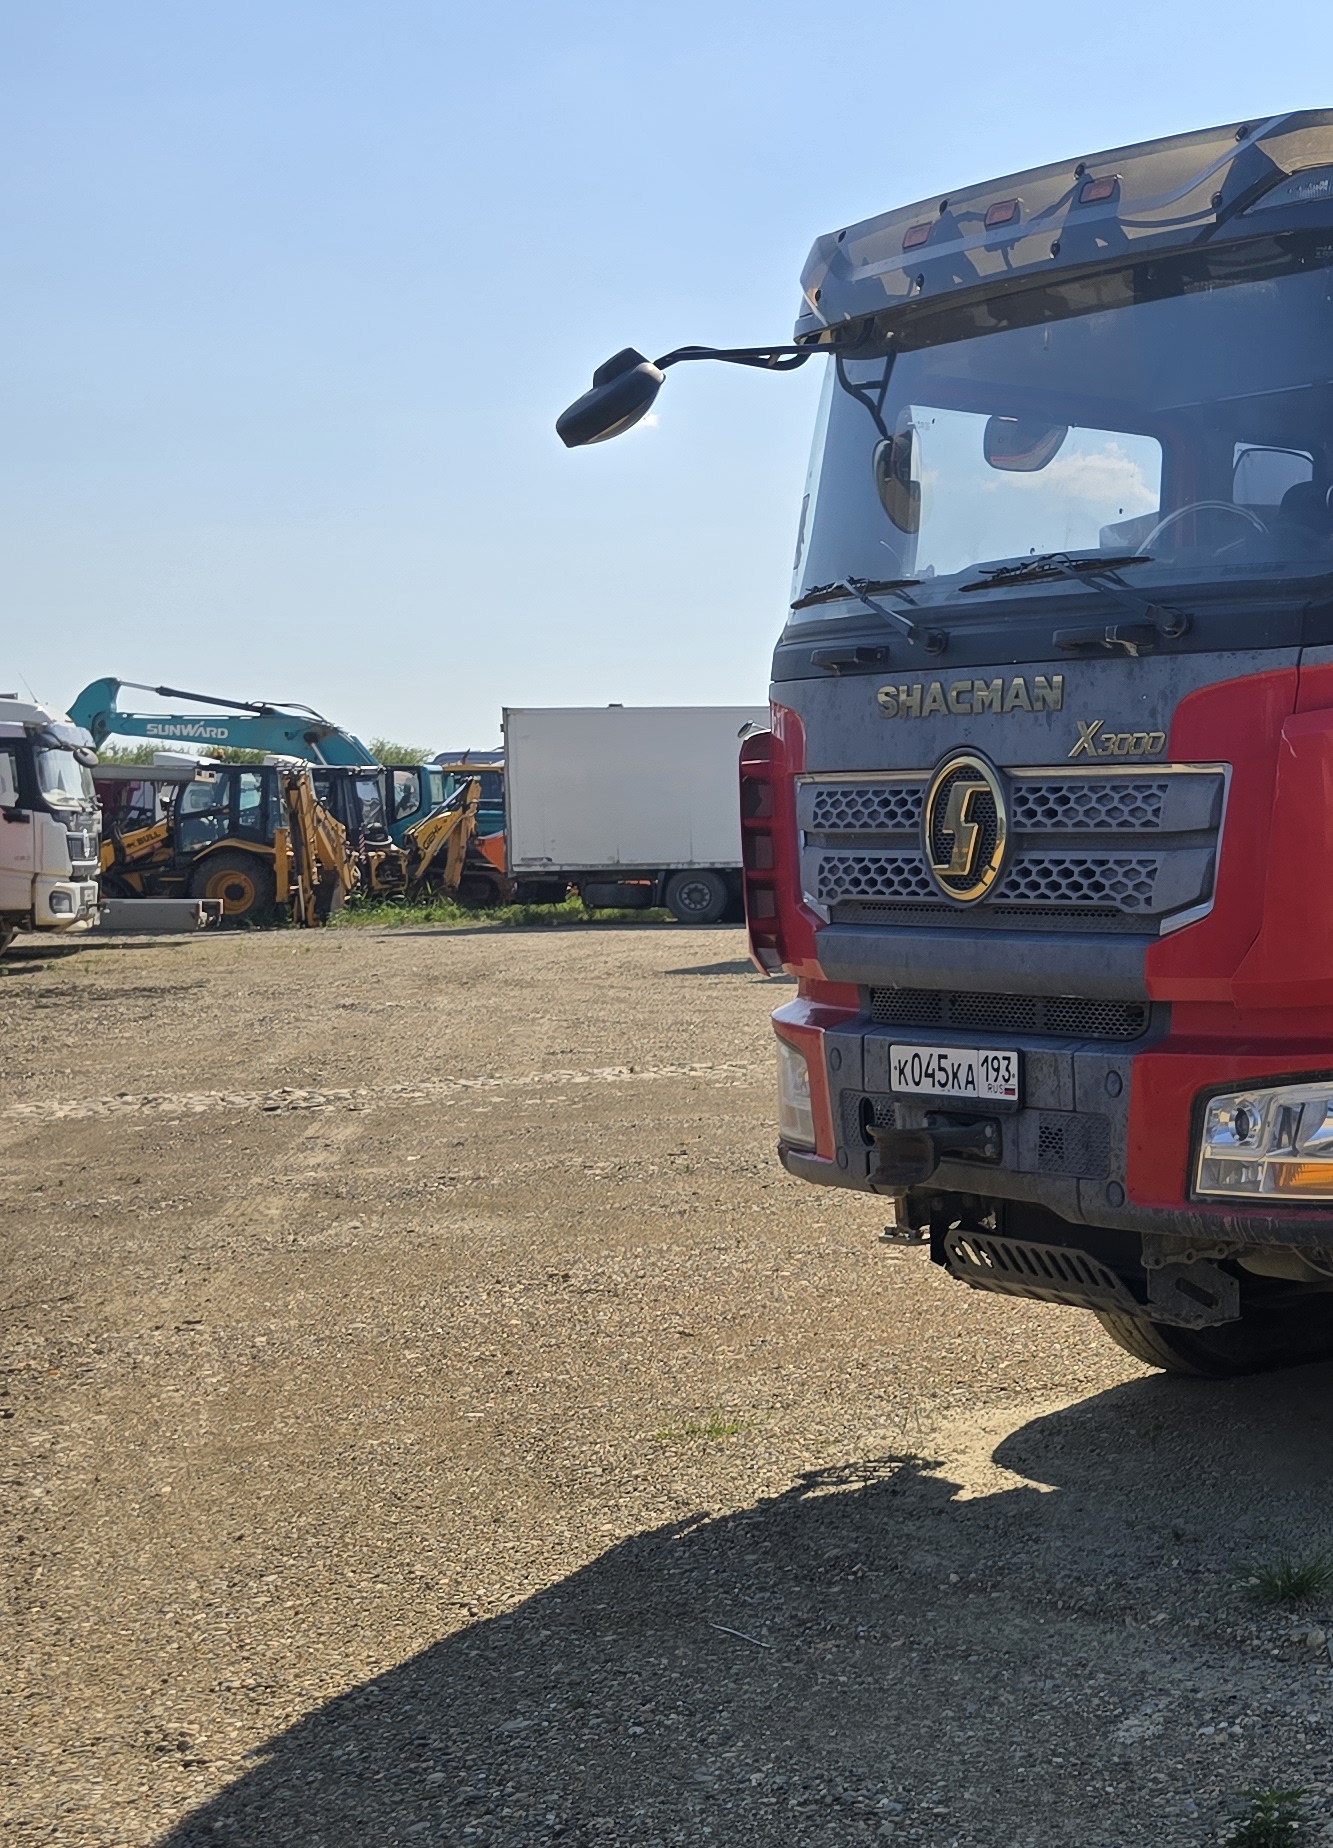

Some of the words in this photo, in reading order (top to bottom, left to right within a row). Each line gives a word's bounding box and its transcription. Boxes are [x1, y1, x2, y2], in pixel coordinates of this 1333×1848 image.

[877, 675, 1063, 719] SHACMAN
[146, 720, 229, 739] SUNWARD
[1067, 719, 1166, 757] X3000
[897, 1052, 976, 1091] К045КА
[980, 1054, 1011, 1084] 193
[987, 1083, 1004, 1094] RUS
